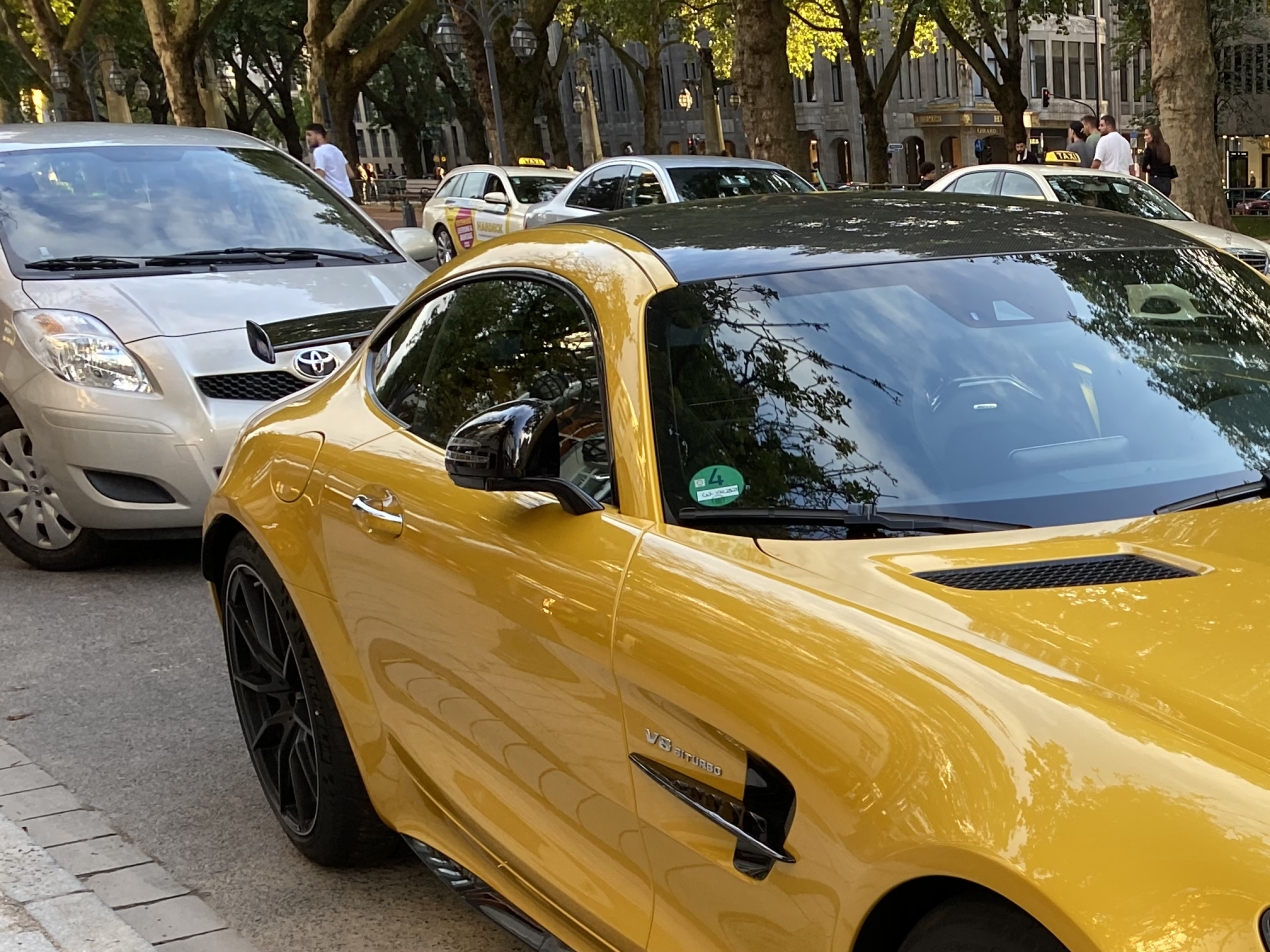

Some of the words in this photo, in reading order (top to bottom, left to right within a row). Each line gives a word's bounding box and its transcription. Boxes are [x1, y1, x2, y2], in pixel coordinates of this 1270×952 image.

[1054, 151, 1079, 161] TAXI
[708, 468, 724, 485] 4
[645, 727, 672, 753] V8
[673, 746, 723, 777] BITURBO
